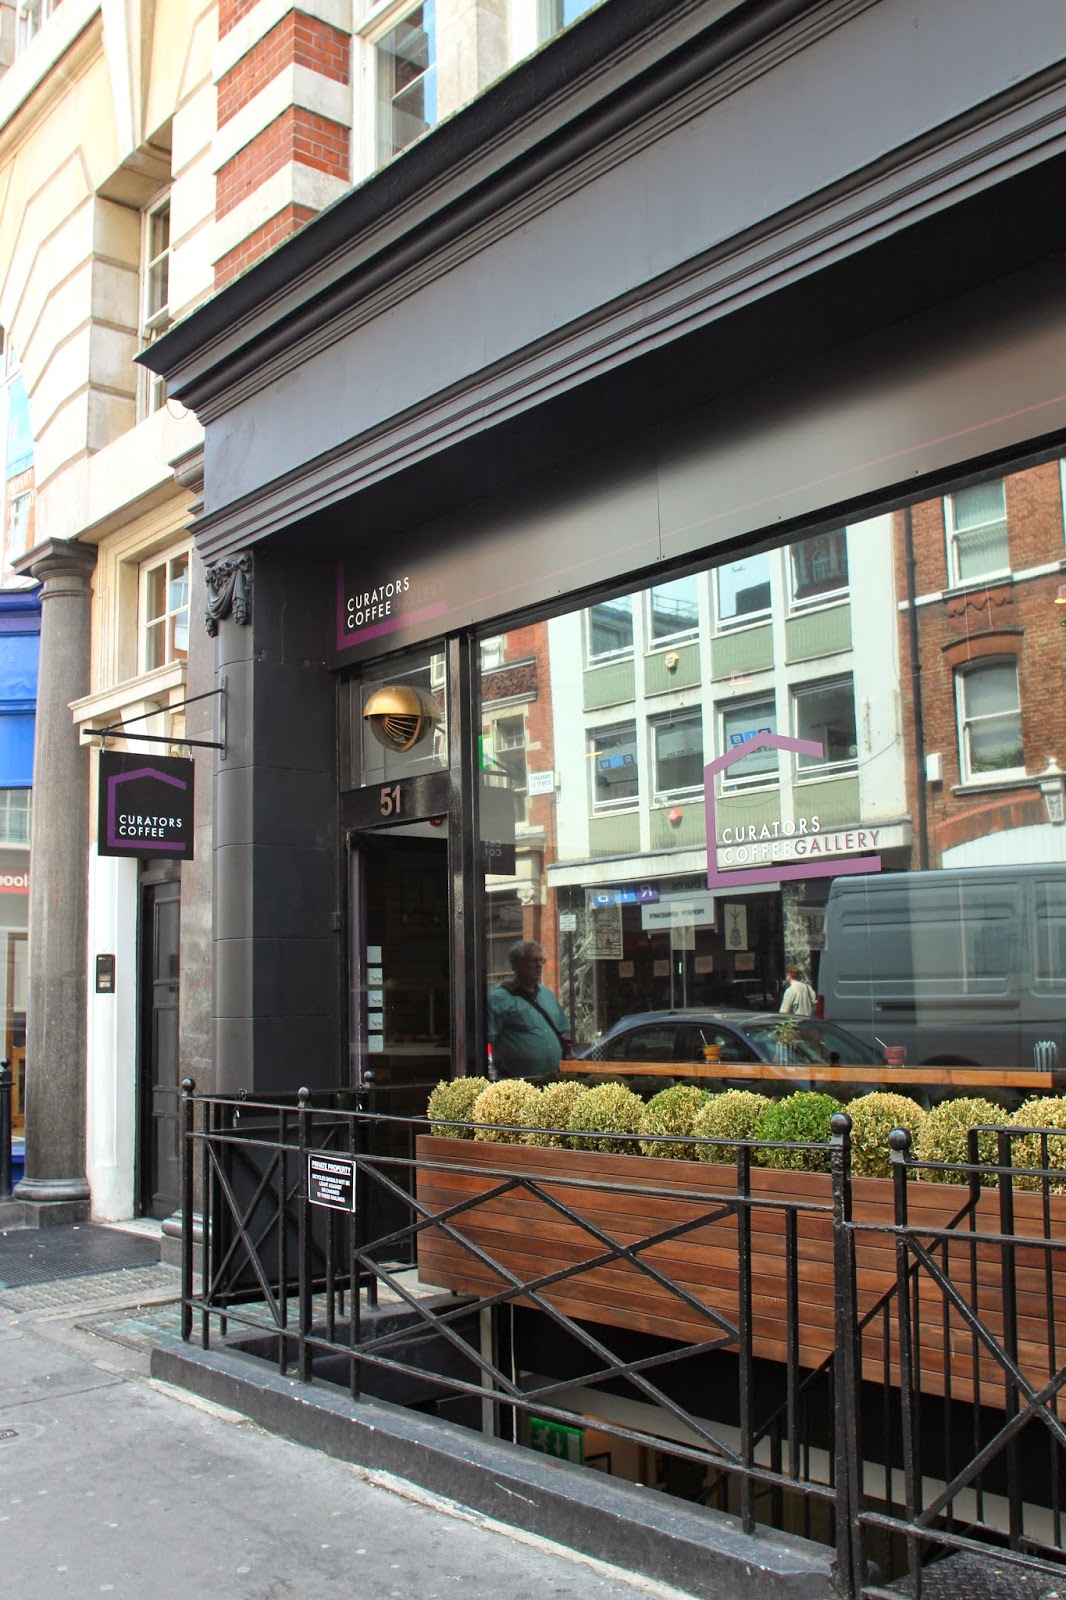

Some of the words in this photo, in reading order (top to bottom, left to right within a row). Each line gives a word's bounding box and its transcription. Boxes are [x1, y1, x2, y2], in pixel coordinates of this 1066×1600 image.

[347, 577, 410, 612] CURATORS
[381, 784, 400, 816] 51
[119, 814, 182, 828] CURATORS
[119, 826, 164, 837] COFFEE
[722, 815, 822, 844] CURATORS
[312, 1160, 327, 1169] PRIVATE
[328, 1163, 351, 1174] PROPERTY
[331, 1195, 345, 1203] RAILINGS
